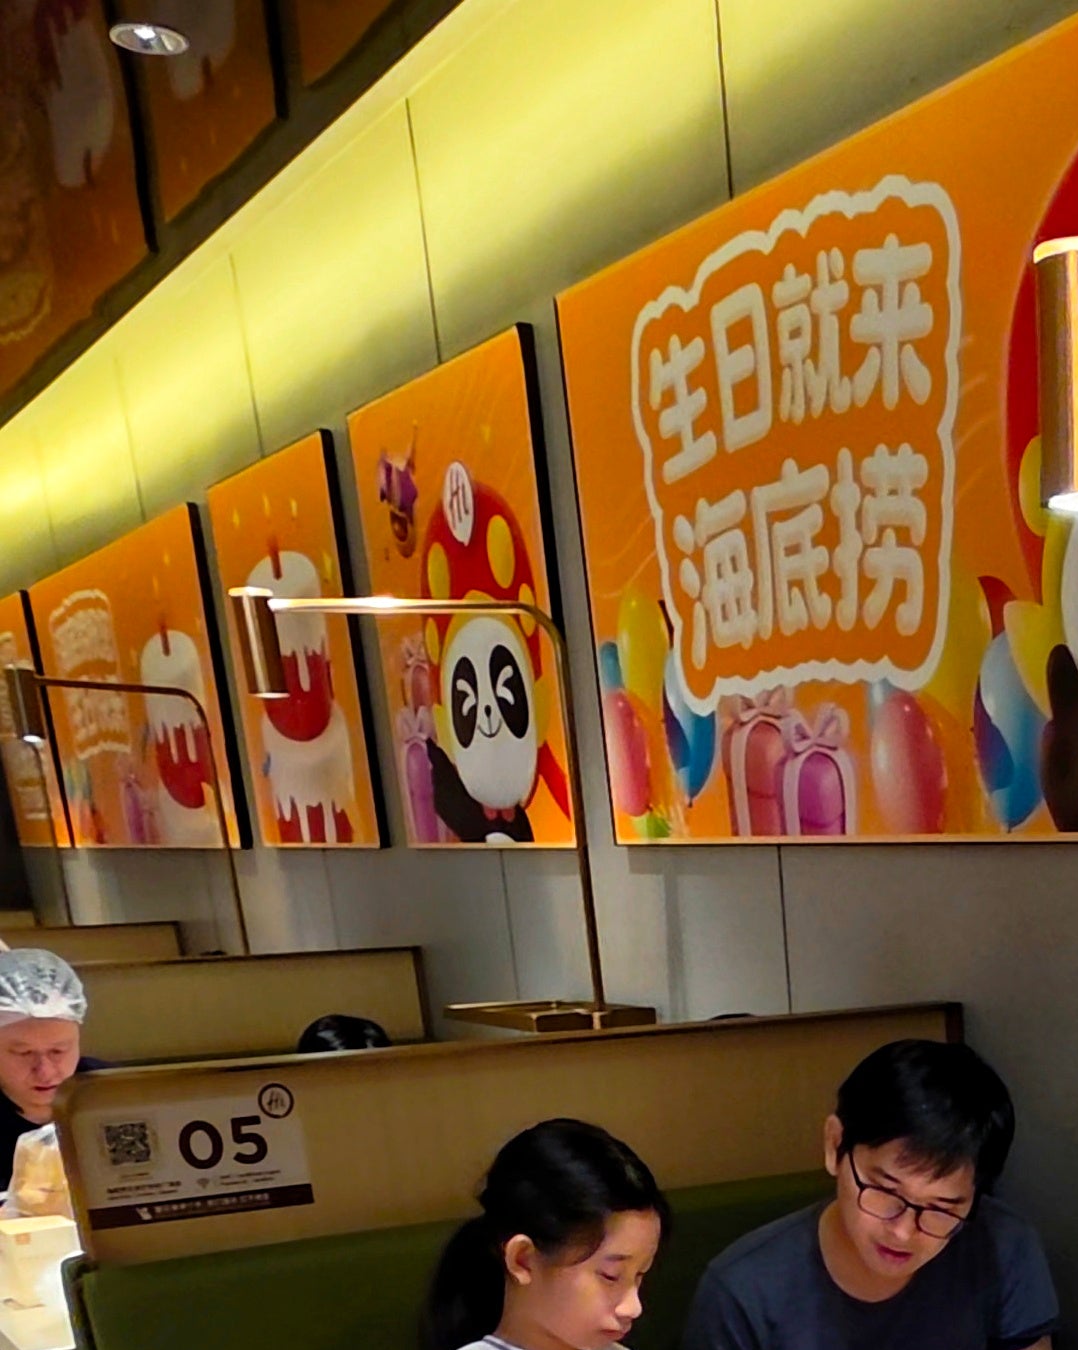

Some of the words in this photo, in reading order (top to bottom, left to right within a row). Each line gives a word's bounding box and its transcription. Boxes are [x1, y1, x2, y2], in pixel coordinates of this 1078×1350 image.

[649, 232, 934, 484] 生日就来
[673, 442, 929, 670] 海底捞
[178, 1115, 268, 1169] 05
